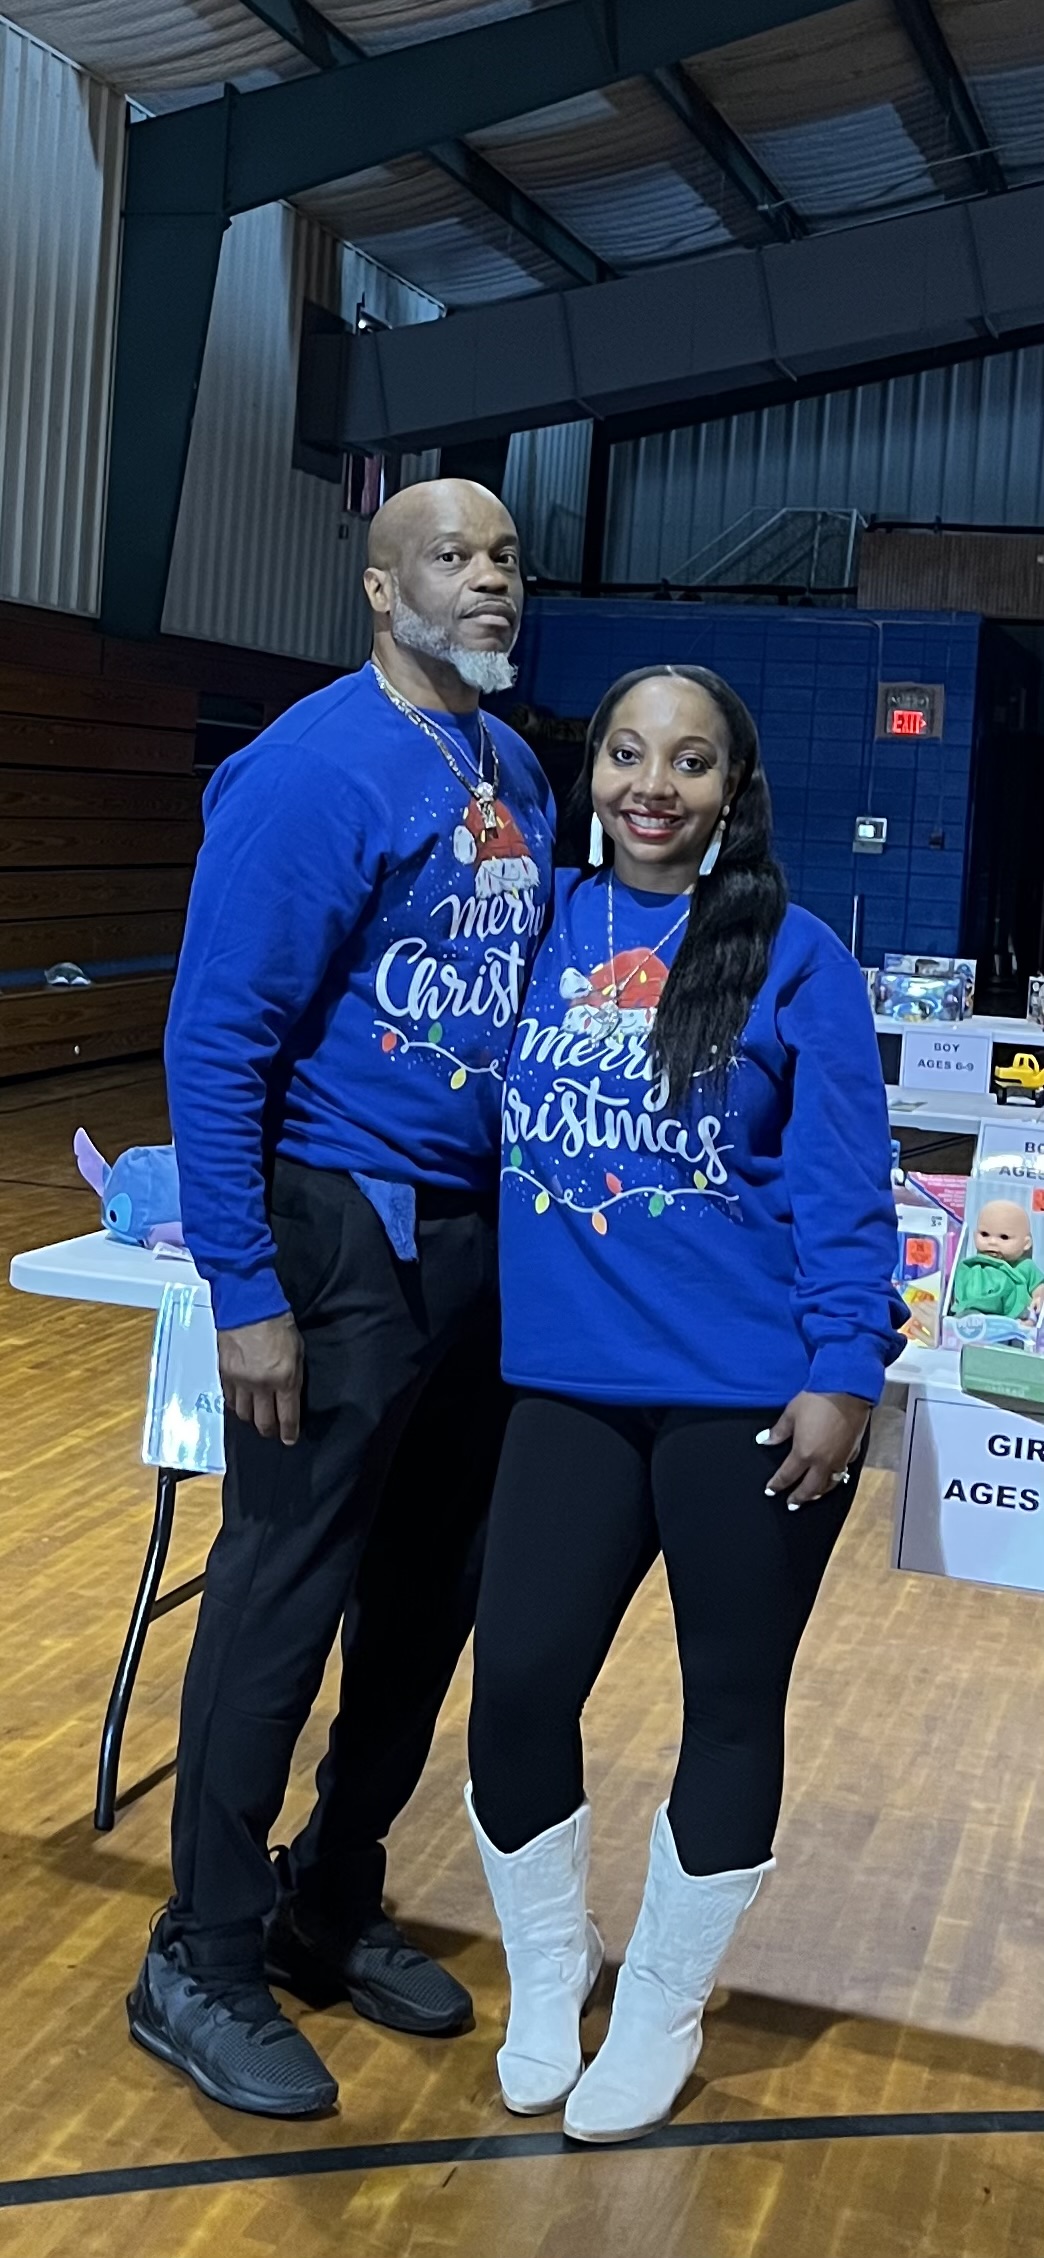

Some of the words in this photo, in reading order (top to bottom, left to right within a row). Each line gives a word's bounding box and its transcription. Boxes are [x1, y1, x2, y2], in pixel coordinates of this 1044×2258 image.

[893, 710, 923, 734] EXIT
[934, 1042, 960, 1052] BOY
[918, 1059, 951, 1070] AGES
[955, 1062, 974, 1071] 6-9
[943, 1479, 1040, 1511] AGES
